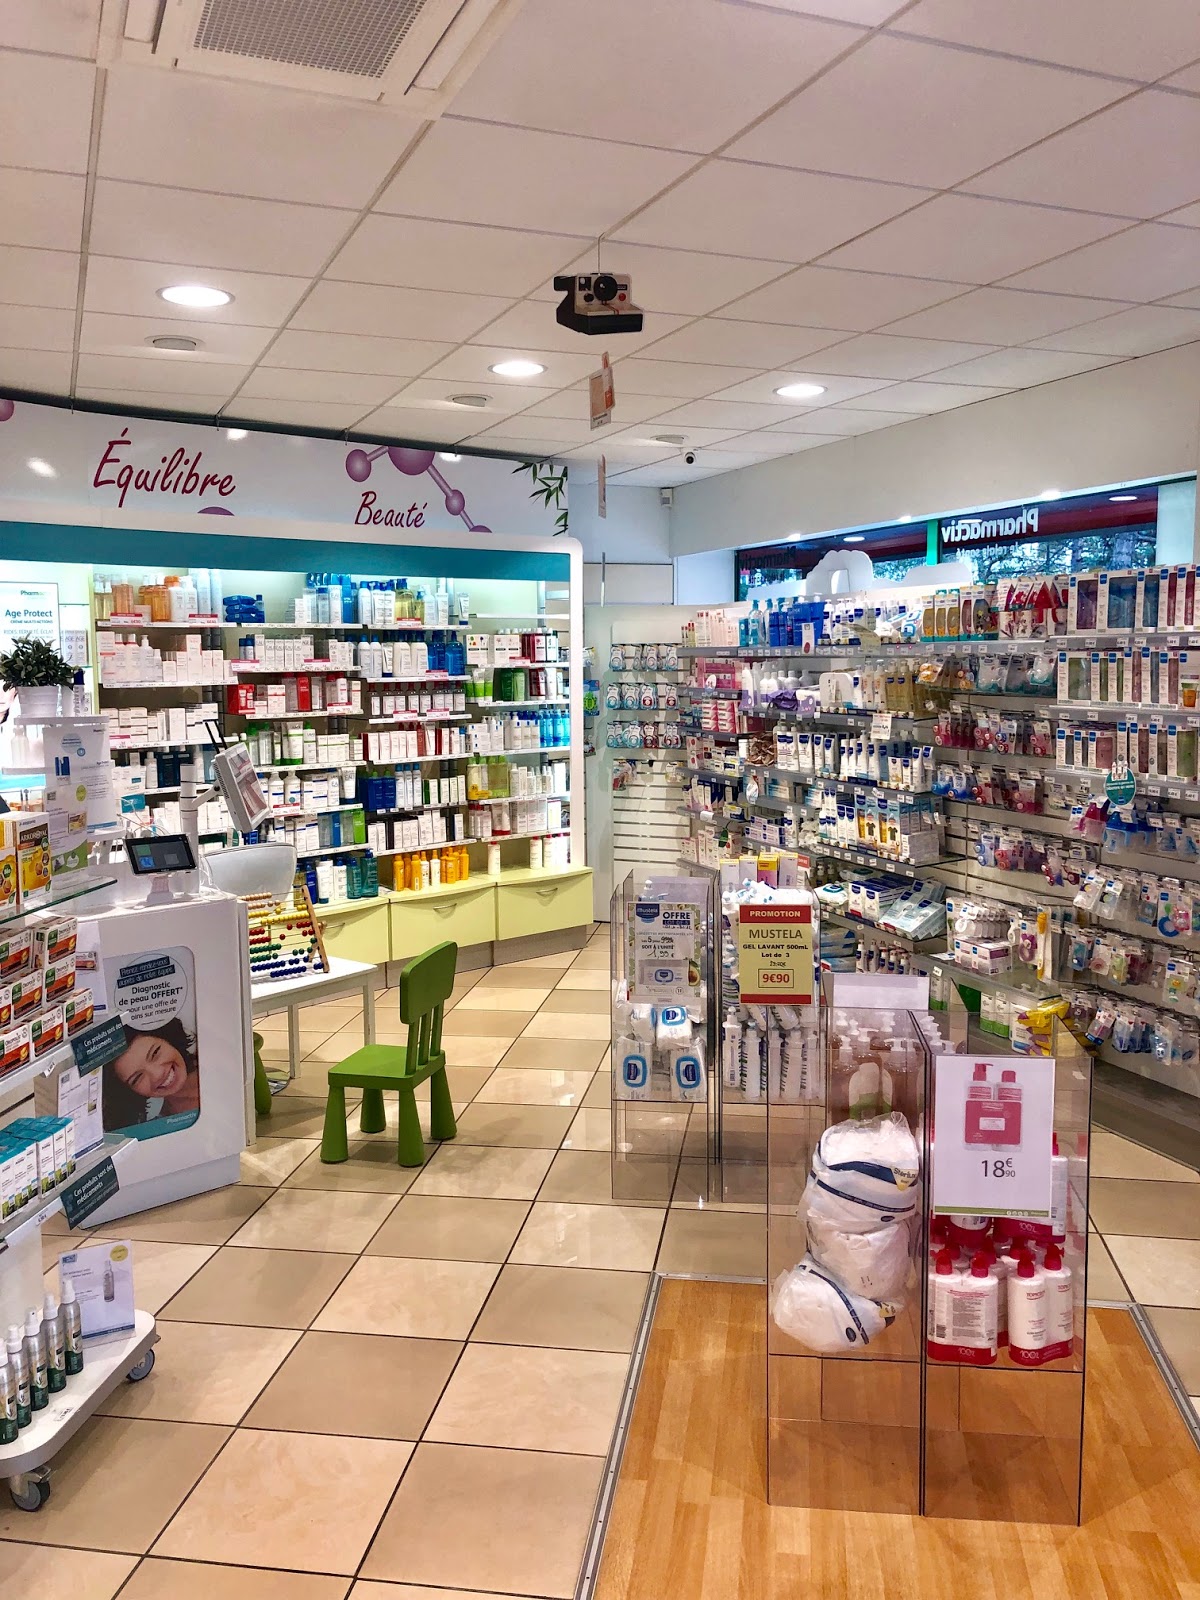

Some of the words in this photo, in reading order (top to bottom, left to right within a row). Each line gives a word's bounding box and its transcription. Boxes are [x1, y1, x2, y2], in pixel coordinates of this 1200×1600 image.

[93, 427, 236, 508] Équilibre
[354, 490, 428, 528] Beauté
[5, 610, 22, 618] Age
[24, 609, 52, 618] Protect
[662, 912, 691, 920] OFFRE
[749, 929, 803, 939] MUSTELA
[762, 973, 790, 983] 9€90
[132, 981, 170, 995] Diagnostic
[119, 998, 128, 1006] de
[130, 995, 149, 1006] peau
[155, 999, 168, 1008] offre
[84, 1038, 92, 1047] Ces
[92, 1030, 107, 1045] produits
[107, 1026, 115, 1035] sont
[86, 1037, 112, 1055] médicaments
[74, 1188, 82, 1197] Ces
[82, 1176, 98, 1192] produits
[98, 1169, 106, 1179] sont
[77, 1182, 103, 1205] médicaments
